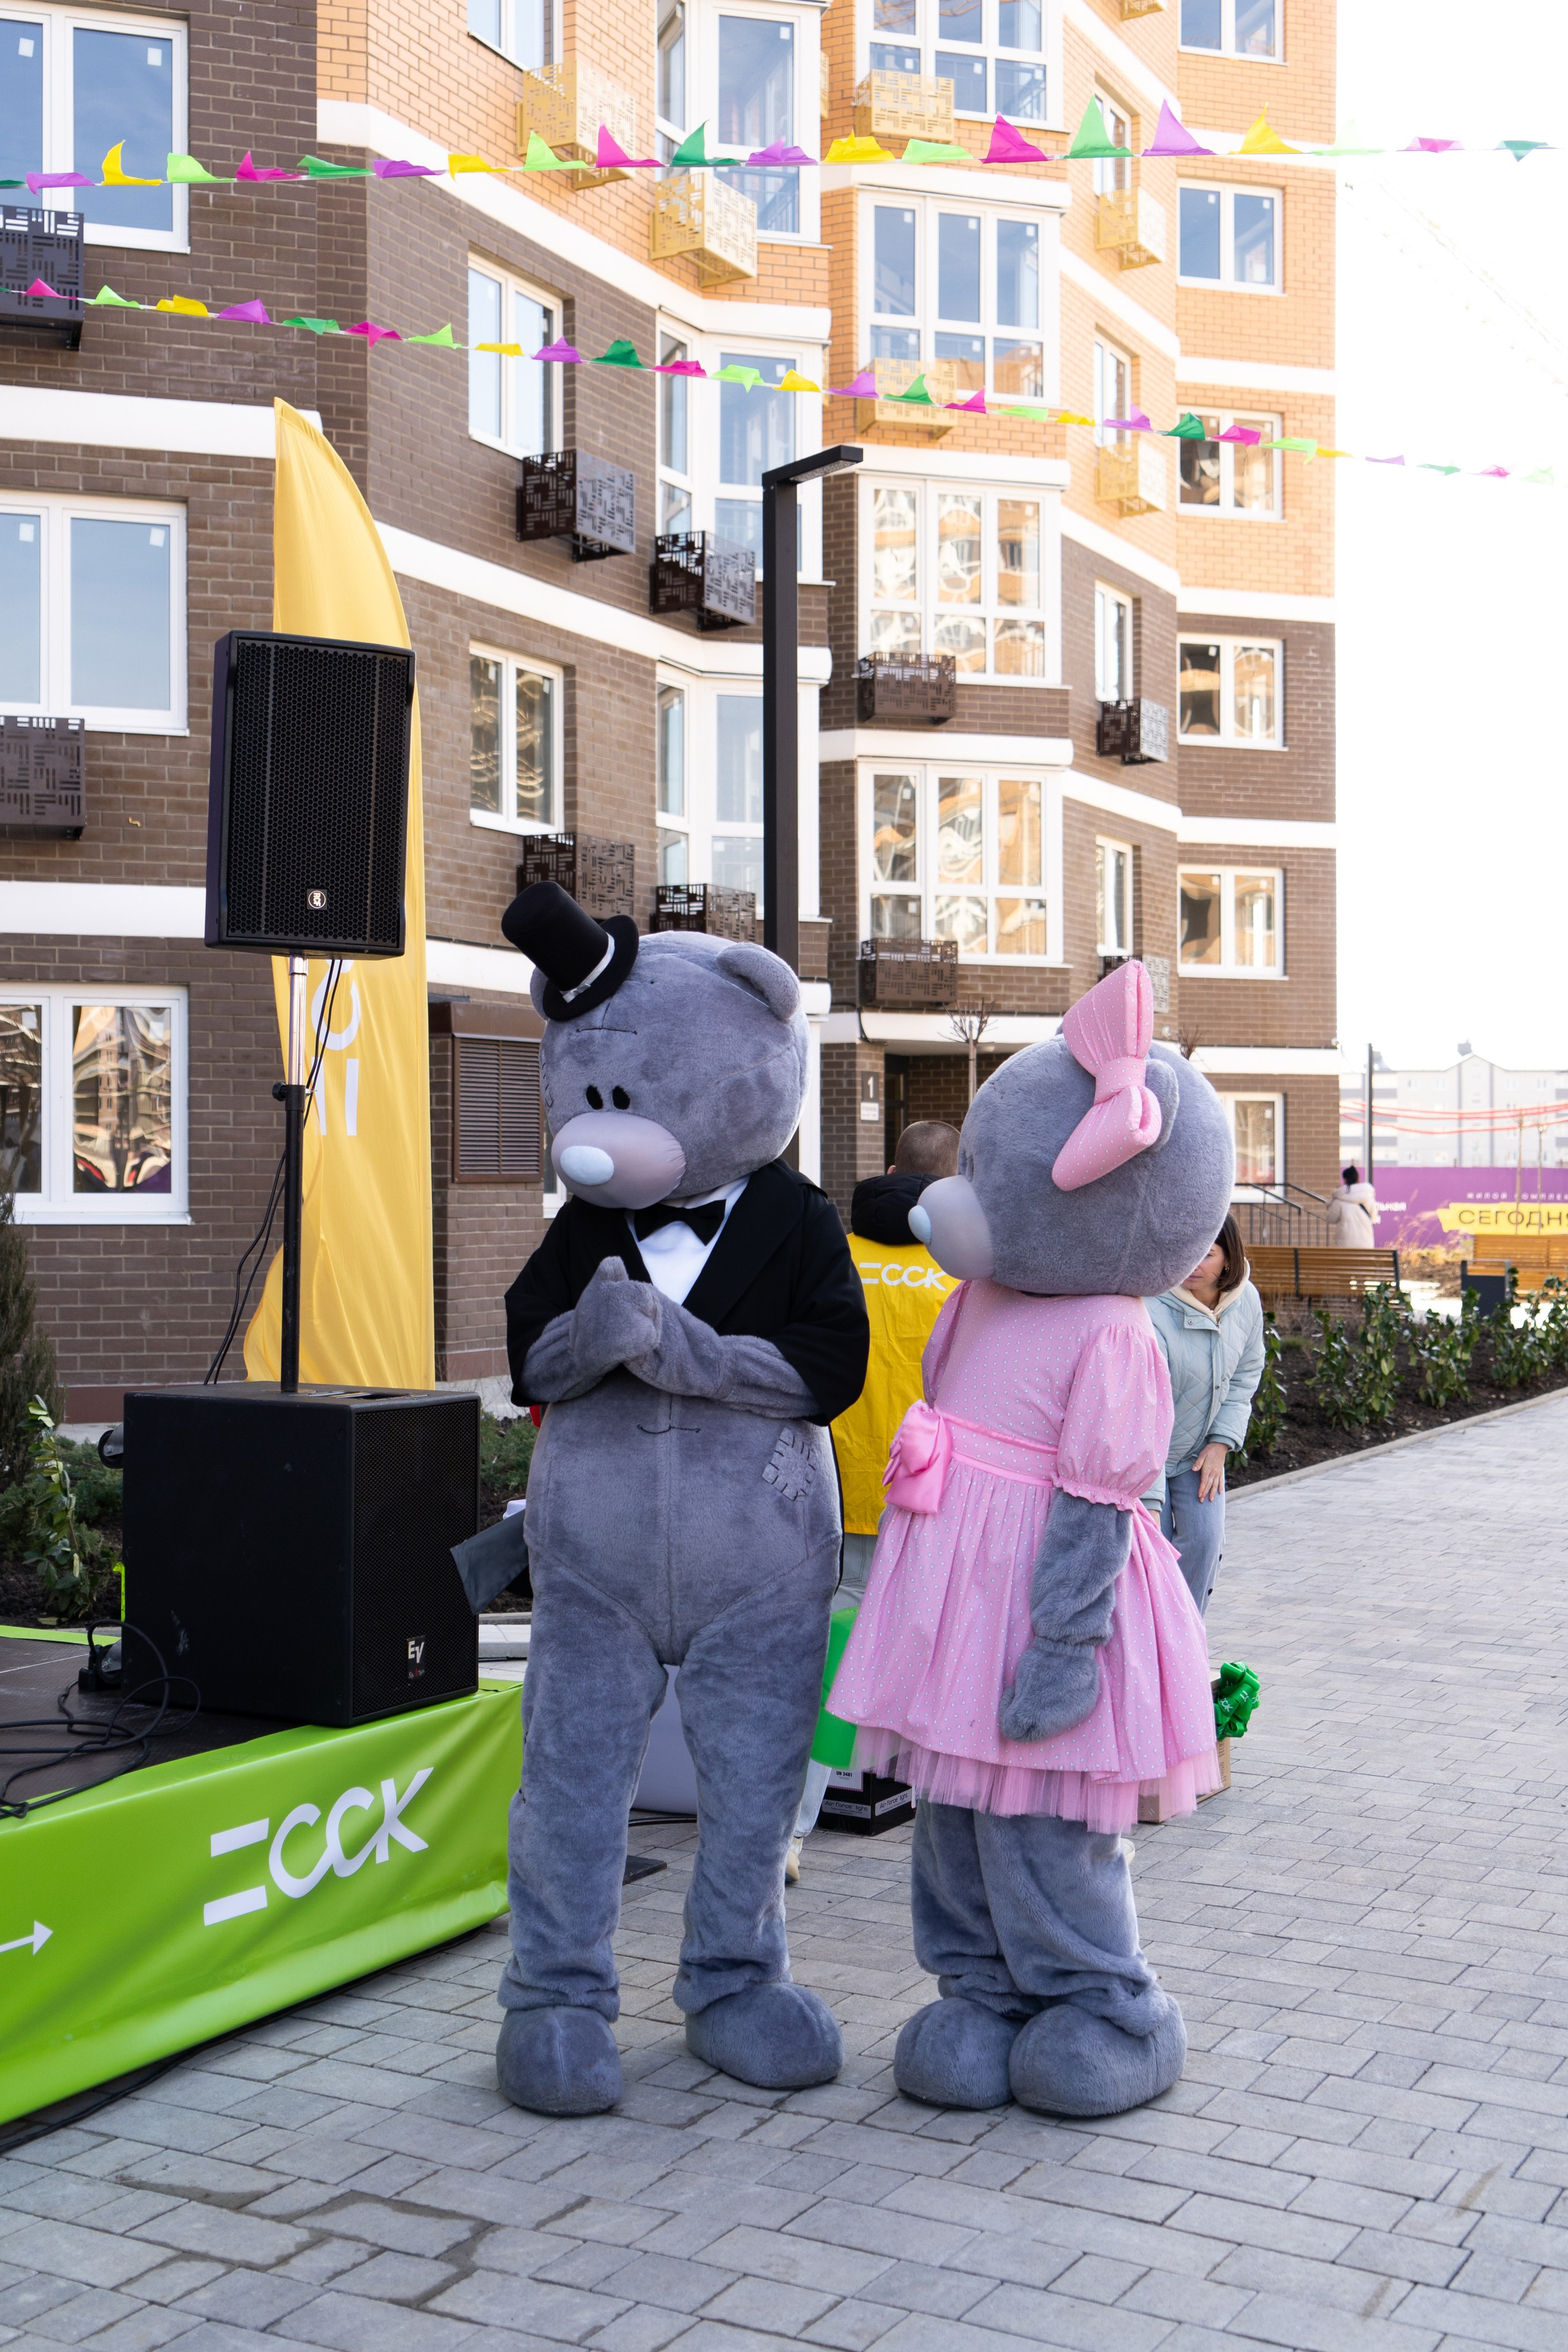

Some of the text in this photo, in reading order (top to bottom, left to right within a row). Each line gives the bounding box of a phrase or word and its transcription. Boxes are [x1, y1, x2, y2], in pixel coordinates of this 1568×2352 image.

[313, 892, 322, 907] RCF
[867, 1076, 874, 1099] 1
[1458, 1210, 1568, 1228] СЕГОДН
[408, 1640, 425, 1664] EV
